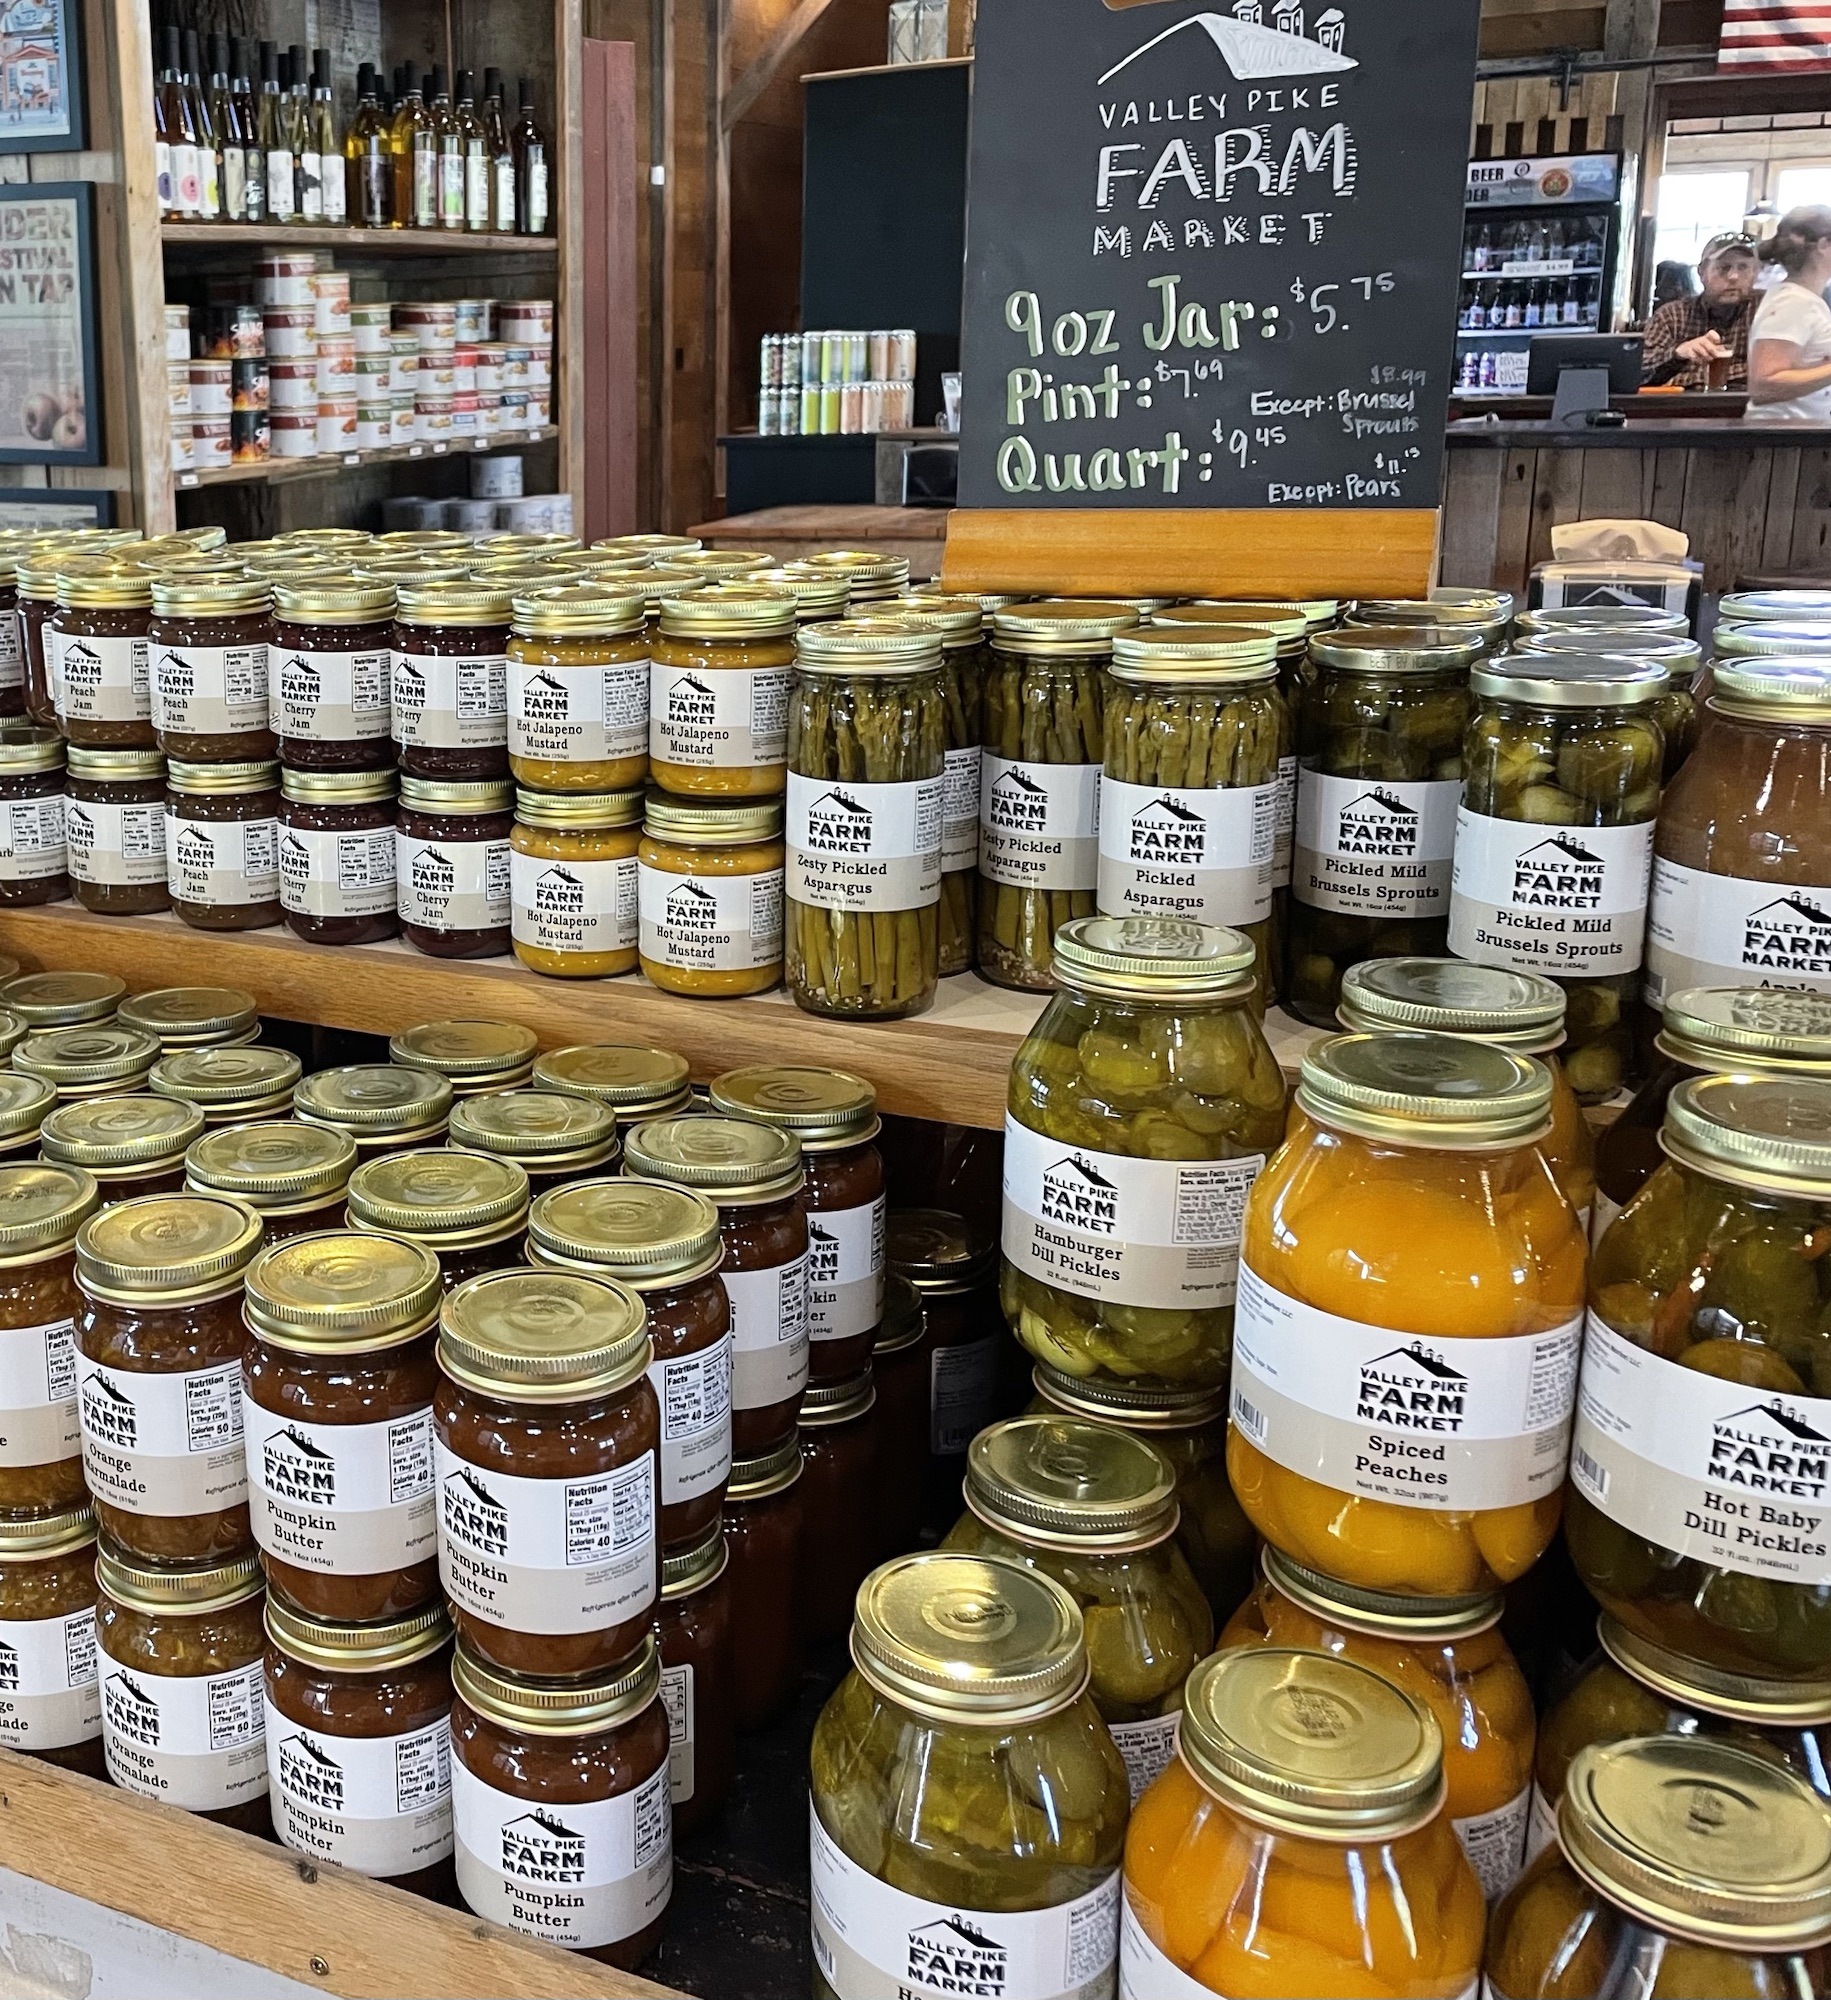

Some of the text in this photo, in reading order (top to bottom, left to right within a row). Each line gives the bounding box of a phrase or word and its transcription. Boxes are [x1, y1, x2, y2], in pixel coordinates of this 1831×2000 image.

[1099, 83, 1340, 128] VALLEY PIKE
[1096, 123, 1357, 212] FARM
[1471, 168, 1504, 182] BEER
[1093, 211, 1332, 258] MARKET
[22, 274, 74, 304] TAP
[1004, 290, 1119, 357] 9oz
[1142, 274, 1280, 352] Jar:
[1005, 364, 1152, 425] Pint:
[1337, 389, 1415, 412] Brussel
[999, 431, 1213, 494] Quart:
[1345, 473, 1401, 500] Pears
[65, 663, 101, 675] FARM
[158, 674, 193, 686] FARM
[282, 680, 320, 693] FARM
[70, 685, 95, 696] Peach
[74, 700, 92, 709] Jam
[163, 697, 188, 709] Peach
[524, 698, 568, 709] FARM
[669, 701, 714, 713] FARM
[167, 712, 185, 721] Jam
[290, 719, 310, 728] Jam
[524, 710, 568, 720] MARKET
[669, 713, 715, 724] MARKET
[517, 720, 582, 736] Hot Jalapeno
[660, 723, 728, 739] Hot Jalapeno
[526, 736, 567, 749] Mustard
[670, 741, 713, 754] Mustard
[991, 799, 1046, 819] FARM
[809, 821, 871, 840] FARM
[983, 830, 1005, 847] Zesty
[1132, 831, 1204, 849] FARM
[1339, 823, 1417, 842] FARM
[177, 847, 214, 858] FARM
[809, 837, 871, 853] MARKET
[1338, 839, 1416, 856] MARKET
[798, 854, 886, 875] Zesty Pickled
[986, 851, 1046, 872] Asparagus
[1131, 848, 1204, 864] MARKET
[183, 869, 208, 880] Peach
[413, 870, 453, 883] FARM
[1136, 869, 1195, 887] Pickled
[1325, 859, 1427, 878] Pickled Mild
[186, 883, 205, 893] Jam
[804, 876, 872, 895] Asparagus
[1310, 875, 1439, 901] Brussels Sprouts
[1515, 872, 1602, 893] FARM
[537, 891, 583, 902] FARM
[1124, 889, 1204, 909] Asparagus
[1512, 890, 1601, 908] MARKET
[422, 908, 443, 918] Jam
[537, 901, 583, 912] MARKET
[667, 906, 716, 919] FARM
[528, 910, 597, 927] Hot Jalapeno
[666, 917, 716, 929] MARKET
[1496, 911, 1612, 933] Pickled Mild
[1746, 918, 1803, 934] VALLEY
[538, 927, 582, 940] Mustard
[657, 926, 730, 944] Hot Jalapeno
[668, 945, 714, 958] Mustard
[1476, 929, 1623, 959] Brussels Sprouts
[1043, 1185, 1116, 1220] FARM
[1042, 1203, 1115, 1233] MARKET
[1034, 1224, 1123, 1261] Hamburger
[1032, 1243, 1120, 1281] Dill Pickles
[188, 1376, 223, 1389] Nutrition
[1360, 1367, 1469, 1393] VALLEY PIKE
[189, 1389, 210, 1398] Facts
[1359, 1381, 1464, 1415] FARM
[83, 1399, 135, 1435] FARM
[691, 1410, 701, 1420] 40
[1357, 1404, 1462, 1432] MARKET
[217, 1423, 228, 1434] 50
[392, 1436, 413, 1447] Facts
[1368, 1435, 1445, 1461] Spiced
[90, 1443, 131, 1471] Orange
[1712, 1439, 1827, 1480] FARM
[265, 1457, 335, 1490] FARM
[418, 1470, 427, 1481] 40
[1355, 1456, 1448, 1484] Peaches
[1708, 1462, 1826, 1499] MARKET
[265, 1476, 335, 1505] MARKET
[569, 1484, 607, 1497] Nutrition
[569, 1498, 593, 1507] Facts
[267, 1499, 336, 1531] Pumpkin
[444, 1494, 507, 1543] FARM
[1703, 1491, 1821, 1534] Hot Baby
[274, 1523, 323, 1550] Butter
[569, 1536, 610, 1547] Calories 40
[1685, 1511, 1826, 1556] Dill Pickles
[446, 1539, 508, 1584] Pumpkin
[451, 1565, 496, 1601] Butter
[106, 1694, 159, 1733] FARM
[237, 1721, 249, 1732] 50
[112, 1736, 154, 1767] Orange
[280, 1756, 343, 1797] FARM
[424, 1781, 436, 1792] 40
[283, 1795, 345, 1835] Pumpkin
[288, 1819, 333, 1851] Butter
[502, 1840, 585, 1868] FARM
[555, 1840, 585, 1850] PIKE
[502, 1858, 585, 1882] MARKET
[504, 1881, 585, 1909] Pumpkin
[513, 1904, 571, 1927] Butter
[909, 1946, 1005, 1981] FARM
[908, 1966, 1005, 1997] MARKET
